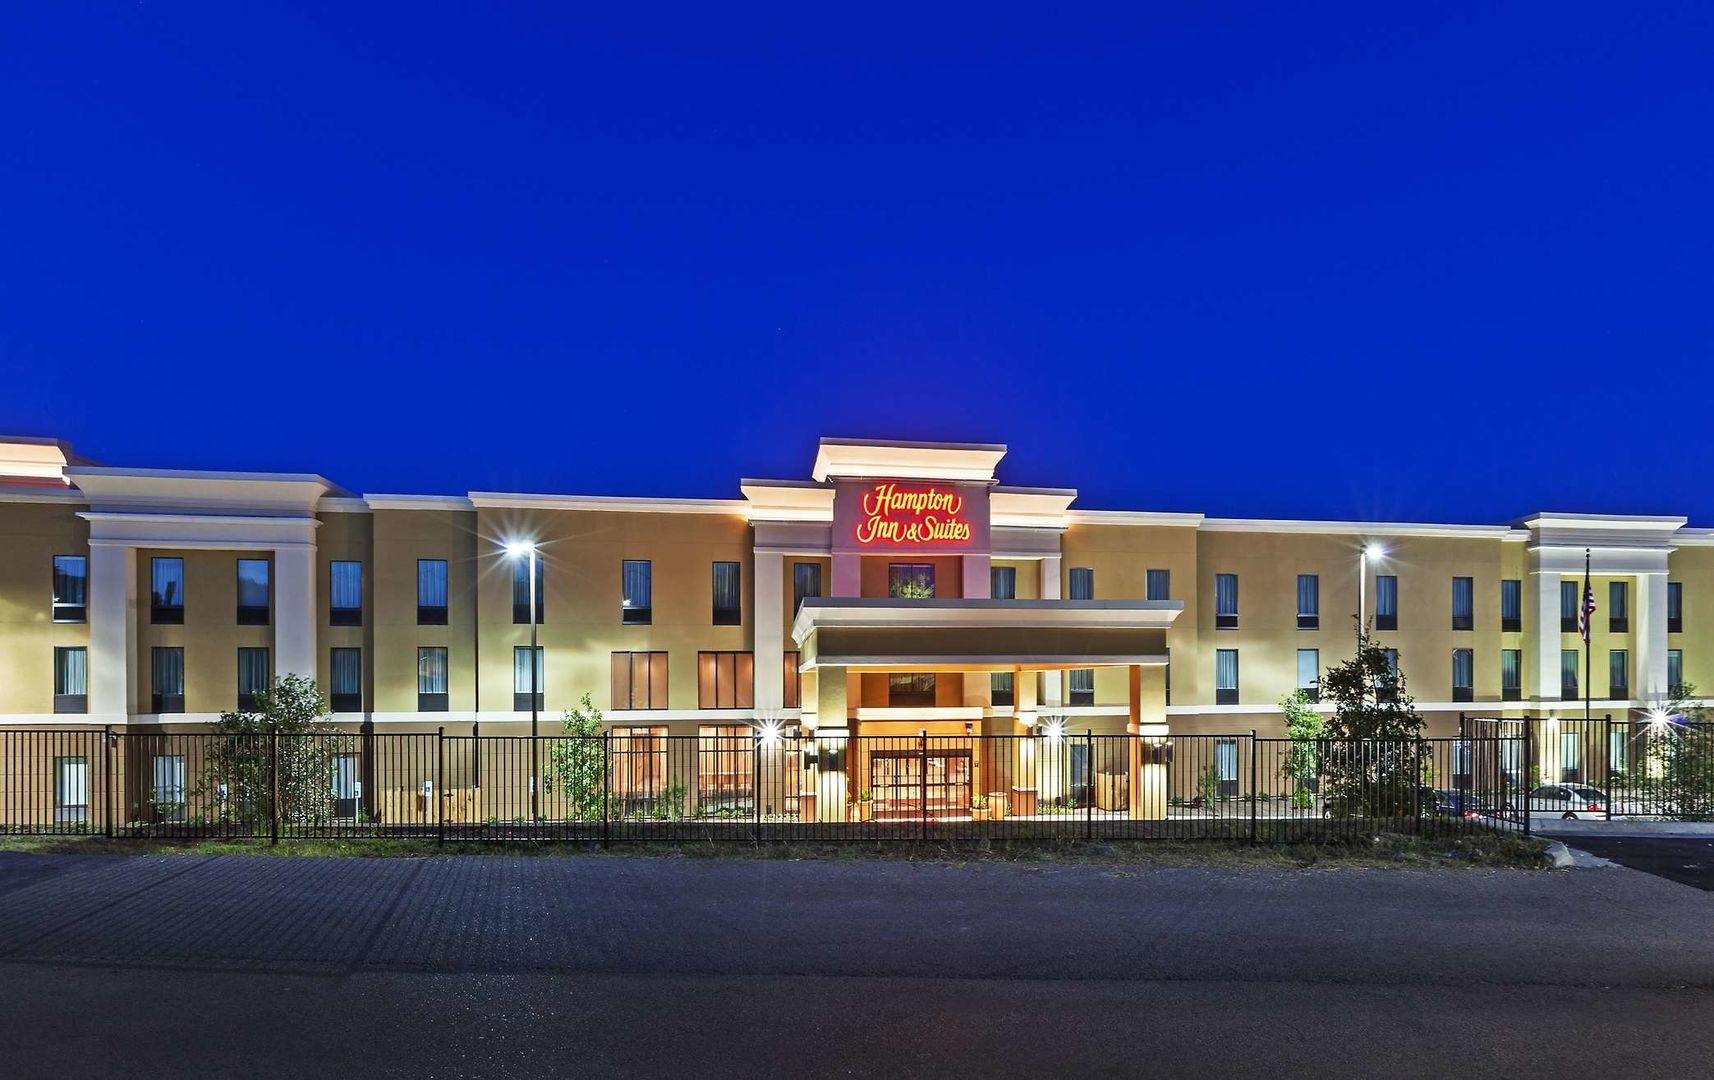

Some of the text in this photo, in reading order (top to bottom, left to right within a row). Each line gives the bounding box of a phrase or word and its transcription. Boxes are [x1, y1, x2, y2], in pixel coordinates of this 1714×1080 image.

[864, 484, 962, 516] Hampton
[857, 516, 970, 543] Inn & Suites
